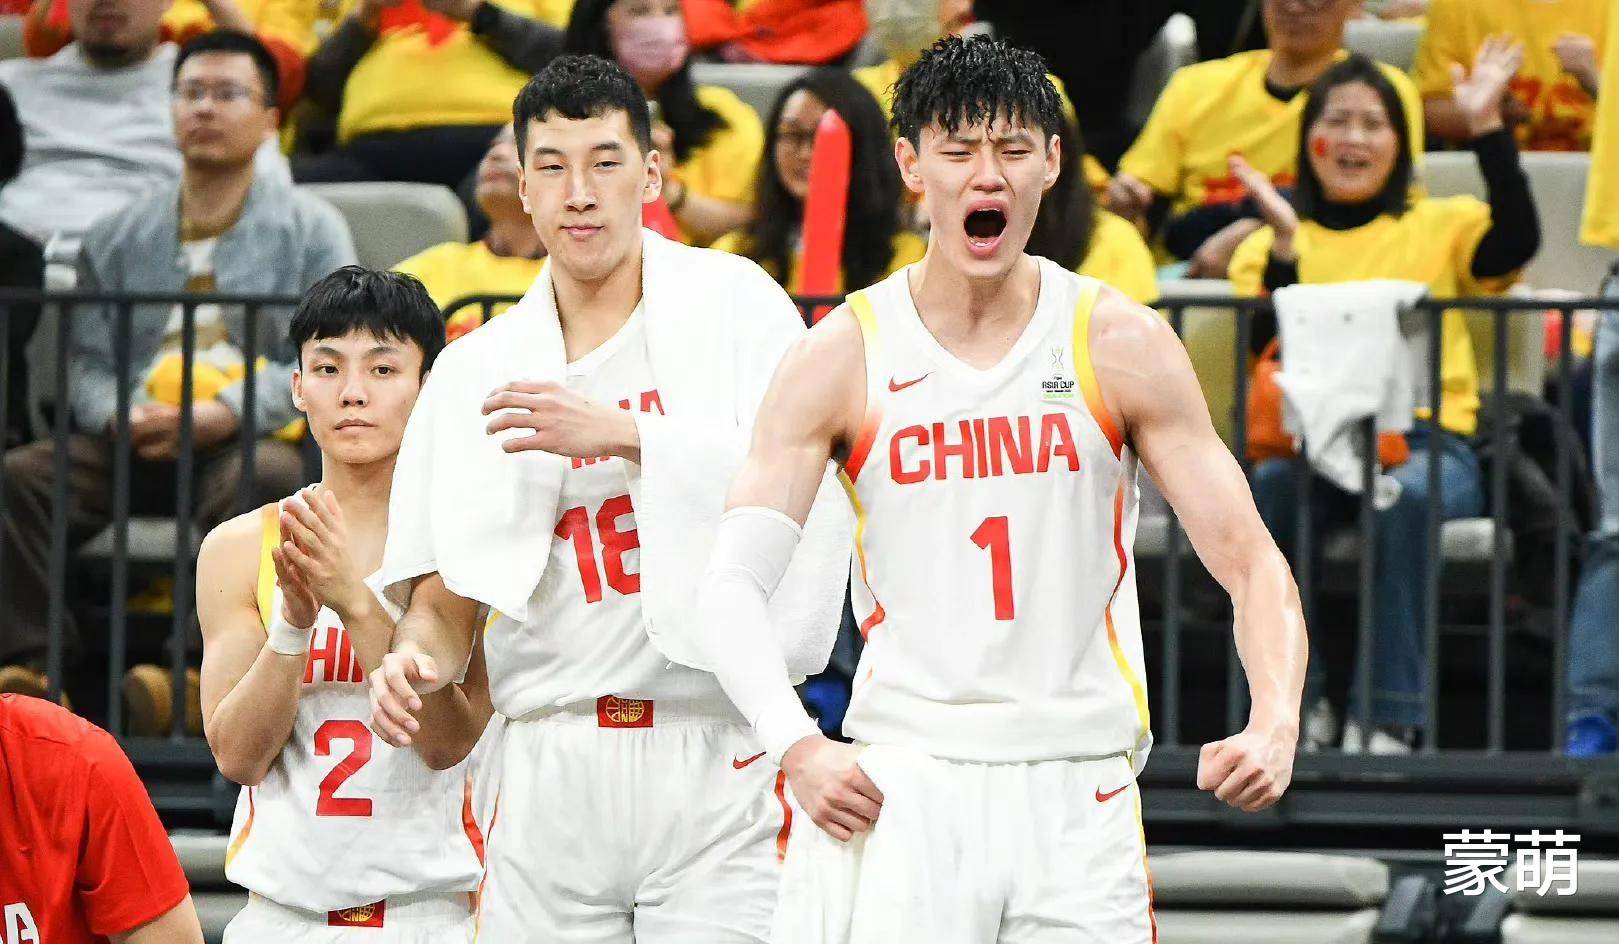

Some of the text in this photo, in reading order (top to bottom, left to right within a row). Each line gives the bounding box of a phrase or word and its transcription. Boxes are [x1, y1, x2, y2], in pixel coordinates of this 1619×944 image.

[1042, 381, 1074, 389] ASIA CUP
[889, 413, 1080, 485] CHINA
[970, 516, 1014, 620] 1
[314, 720, 372, 816] 2
